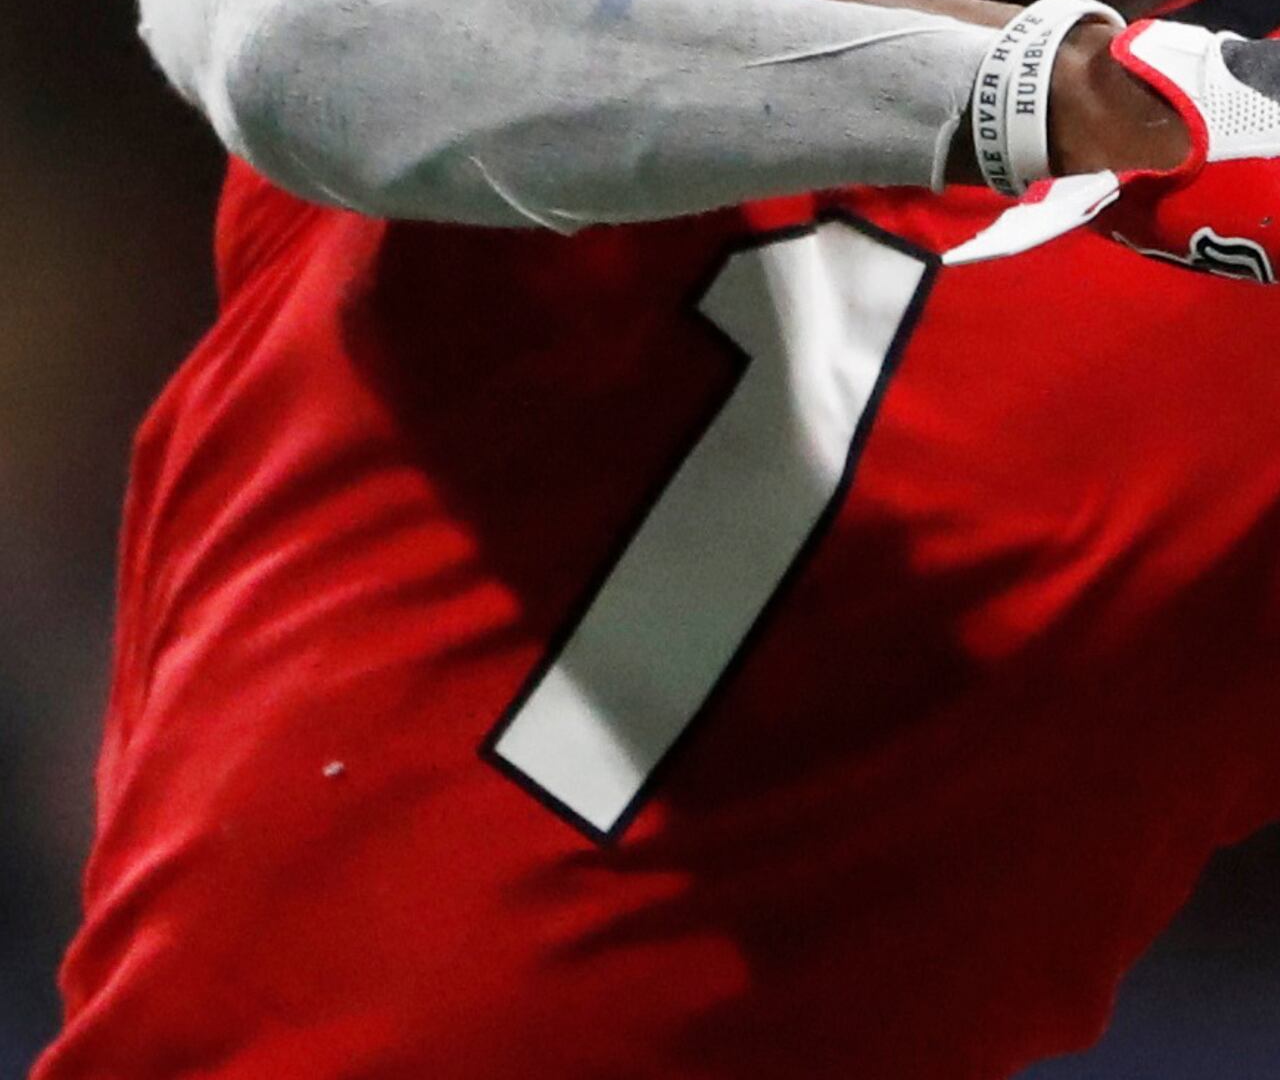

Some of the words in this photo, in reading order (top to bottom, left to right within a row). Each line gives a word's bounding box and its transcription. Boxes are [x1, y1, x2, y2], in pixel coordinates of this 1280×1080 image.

[978, 73, 999, 141] OVER
[992, 14, 1043, 63] HYPE
[477, 214, 942, 845] 1
